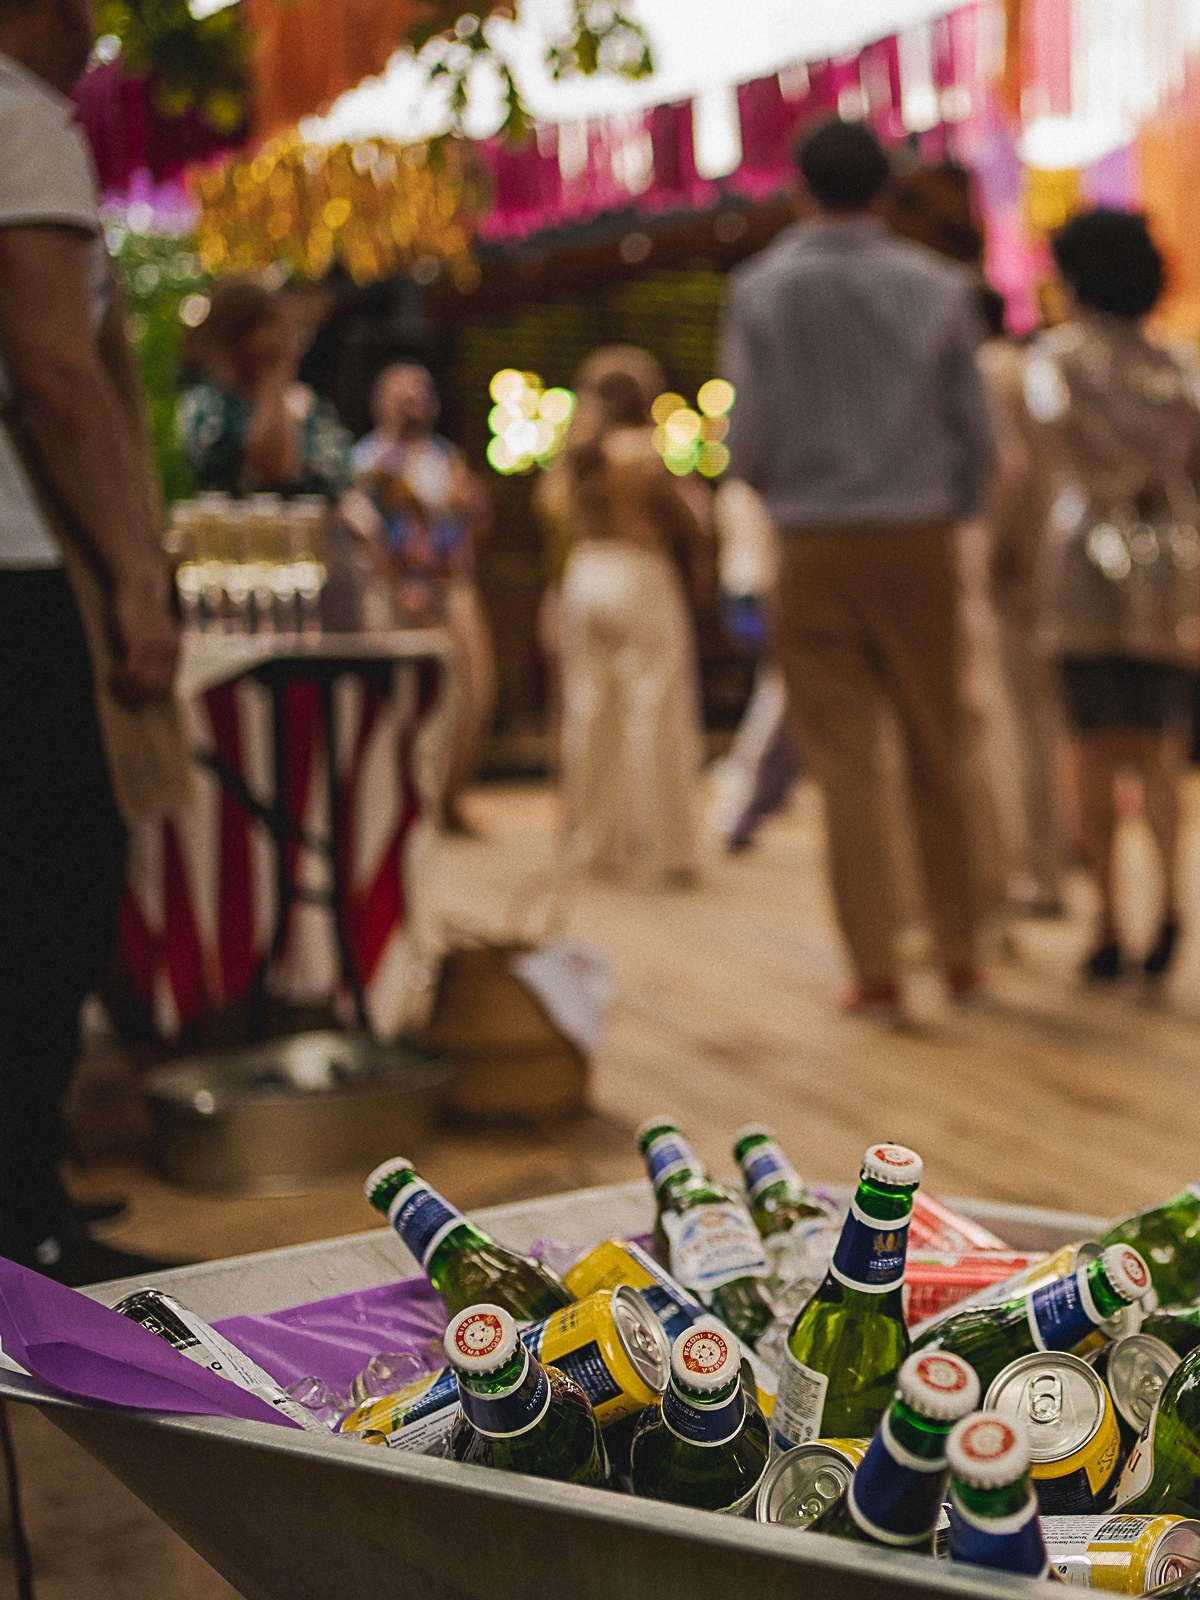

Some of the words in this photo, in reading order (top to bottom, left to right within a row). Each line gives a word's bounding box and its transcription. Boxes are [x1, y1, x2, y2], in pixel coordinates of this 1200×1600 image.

[458, 1315, 480, 1336] BIRRA
[458, 1340, 480, 1356] ROMA
[484, 1327, 502, 1354] PERONI
[684, 1333, 703, 1356] PERONI
[707, 1333, 727, 1352] ROMA
[701, 1356, 727, 1374] BIRRA
